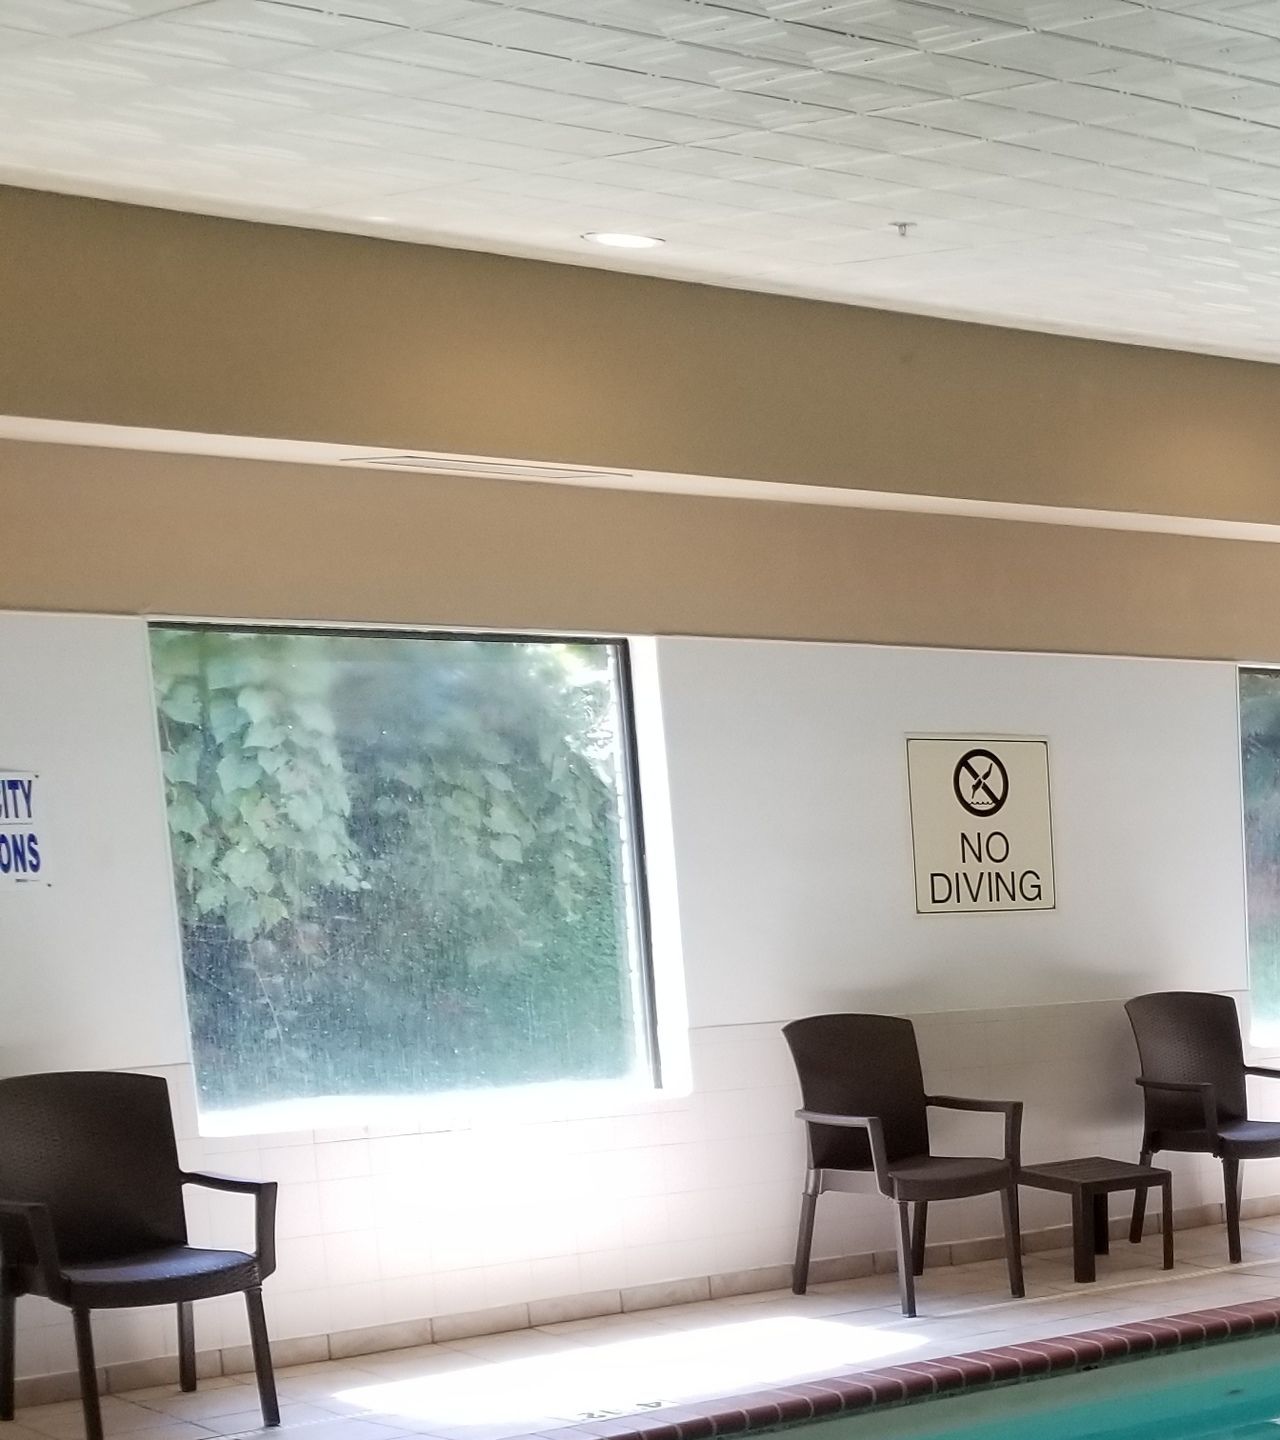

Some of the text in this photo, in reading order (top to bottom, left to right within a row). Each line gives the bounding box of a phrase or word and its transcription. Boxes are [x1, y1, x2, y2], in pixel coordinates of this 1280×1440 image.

[0, 779, 32, 819] ITY
[960, 831, 1010, 864] NO
[929, 870, 1043, 904] DIVING
